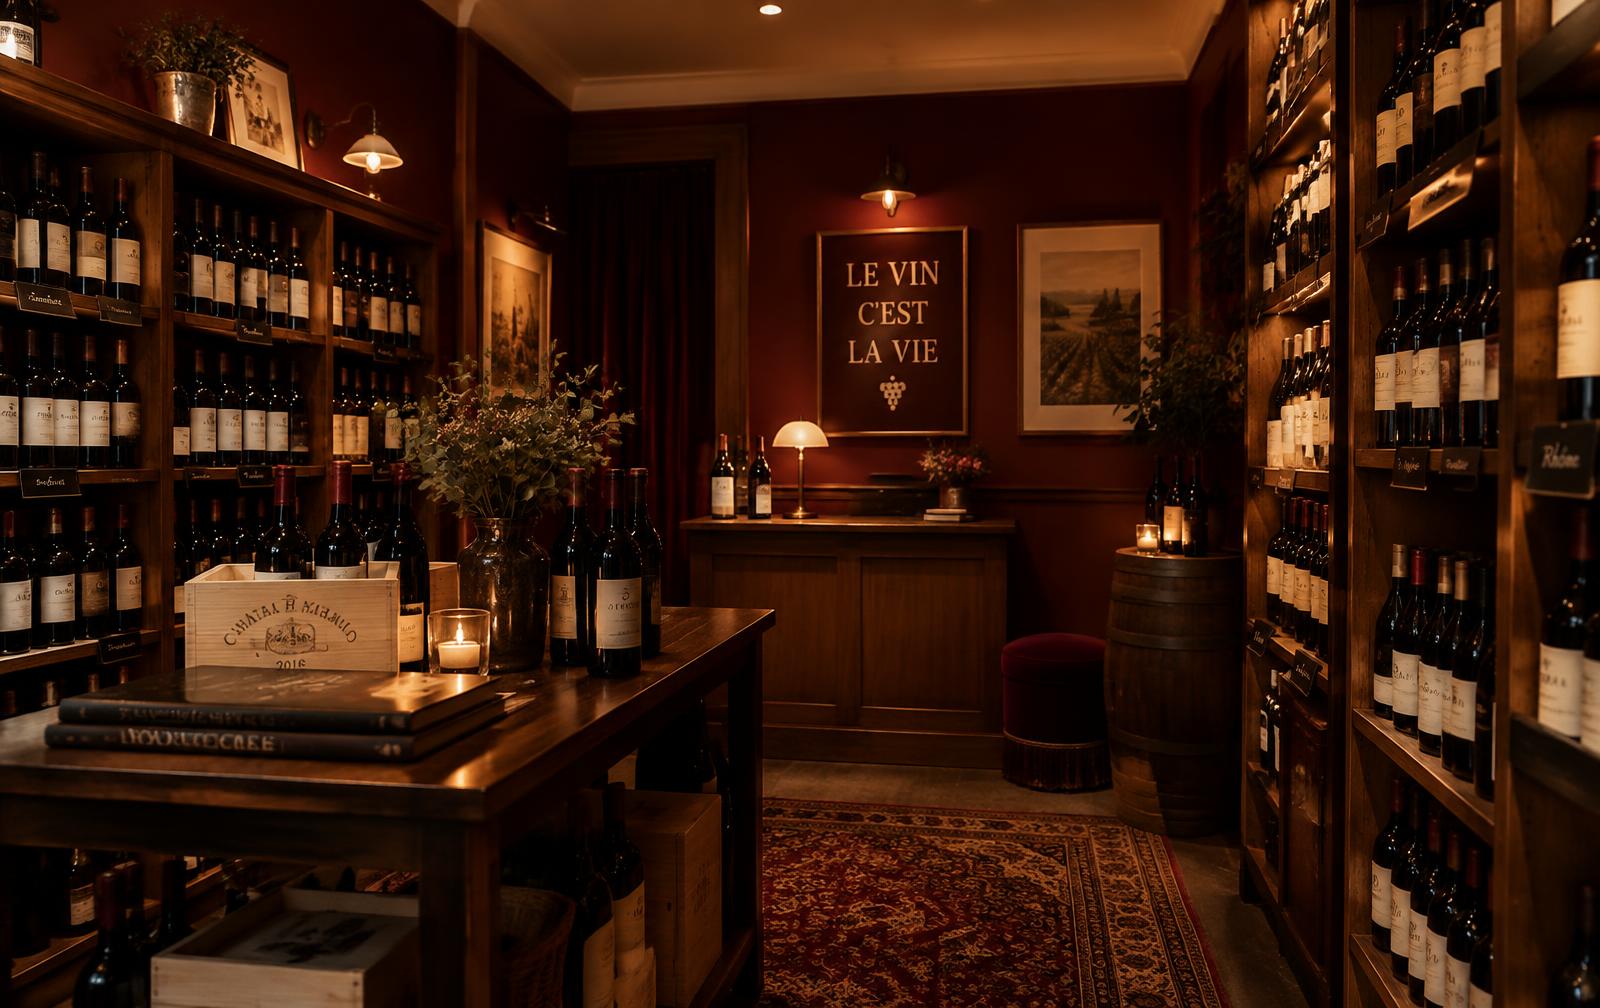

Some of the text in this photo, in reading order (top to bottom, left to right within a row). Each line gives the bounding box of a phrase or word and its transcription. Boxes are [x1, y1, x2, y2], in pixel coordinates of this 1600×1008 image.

[846, 260, 940, 287] LE VIN
[858, 301, 928, 326] C'EST
[848, 338, 938, 364] LA VIE
